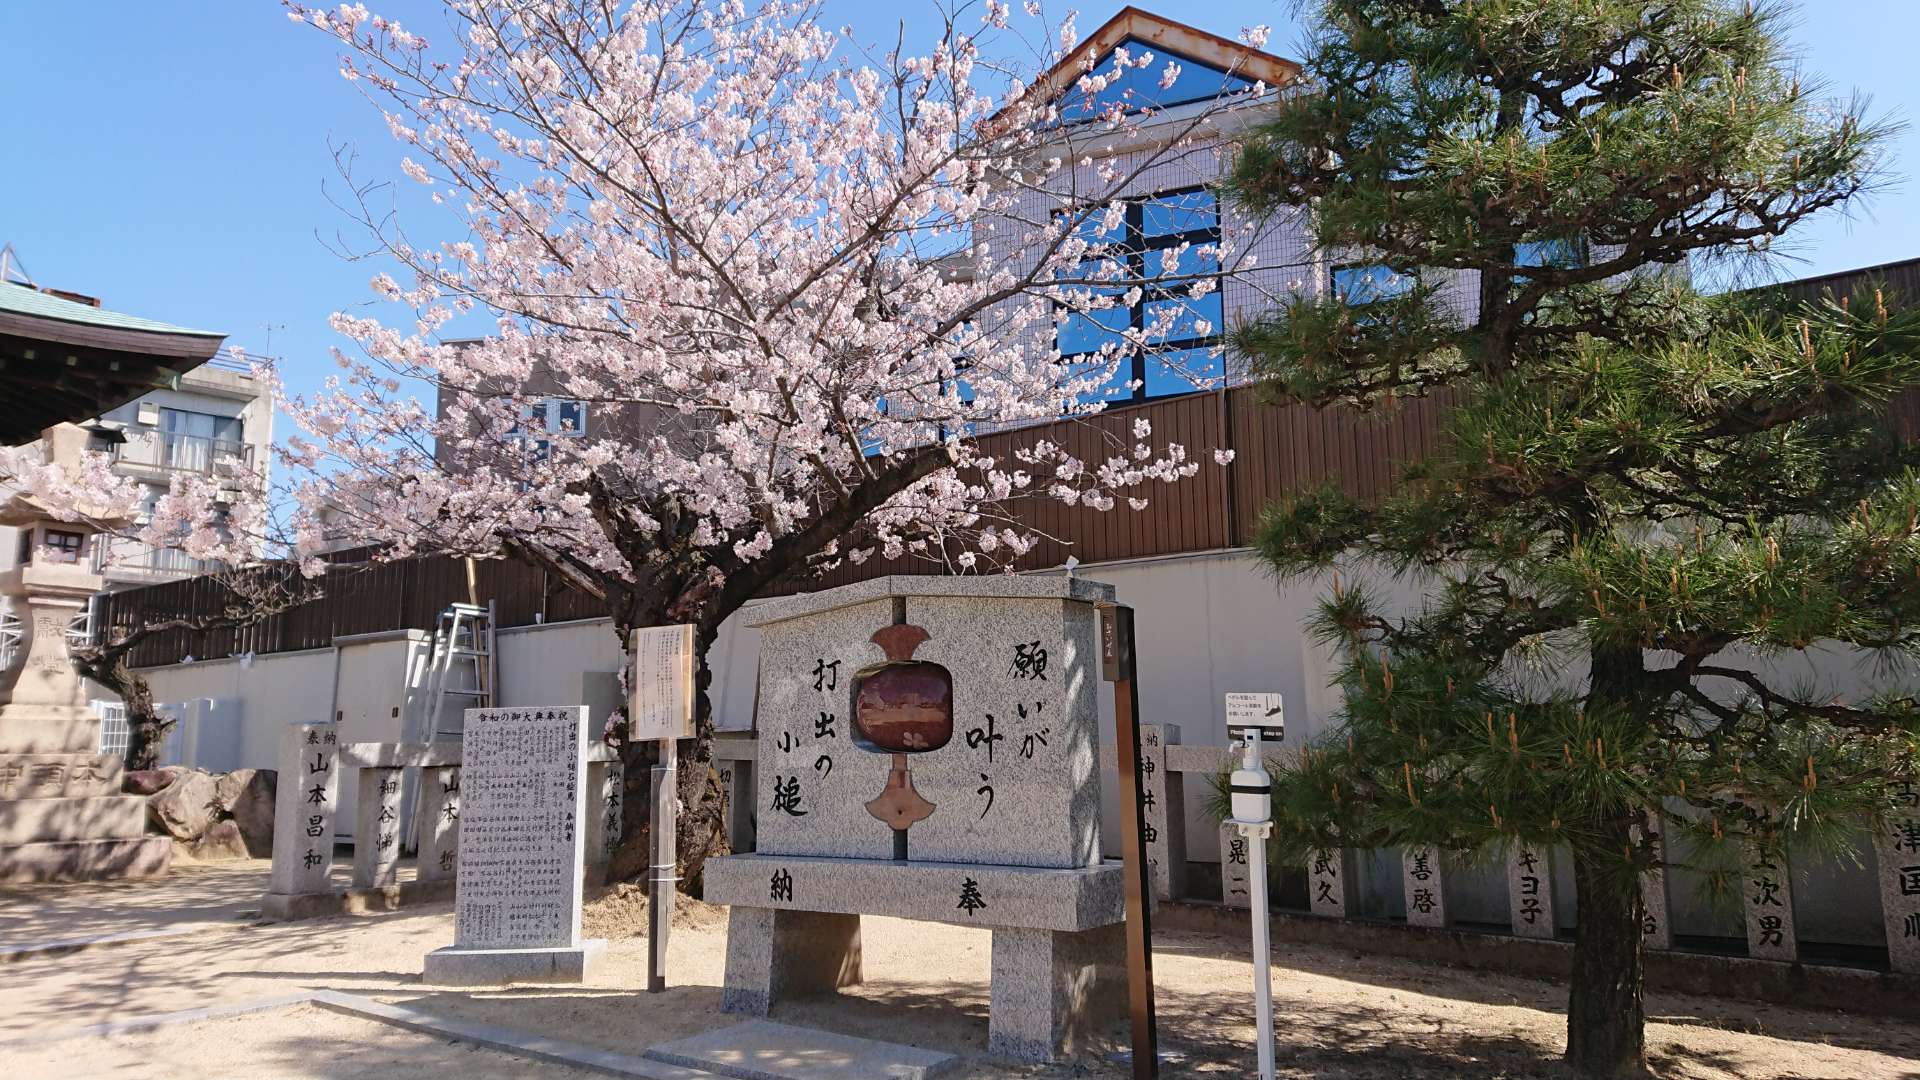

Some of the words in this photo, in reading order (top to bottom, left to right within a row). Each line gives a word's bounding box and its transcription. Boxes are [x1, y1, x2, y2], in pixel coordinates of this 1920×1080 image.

[479, 711, 568, 722] 令和の御大典奉祝
[812, 658, 842, 780] 打出の
[1005, 640, 1050, 760] 願いが
[769, 731, 808, 817] 小槌
[965, 714, 1004, 820] 叶う
[303, 752, 329, 870] 山本昌和
[769, 867, 794, 903] 納
[956, 877, 988, 917] 奉
[1228, 839, 1248, 895] 晃二
[1314, 850, 1338, 905] 武久
[1410, 853, 1437, 914] 善啓
